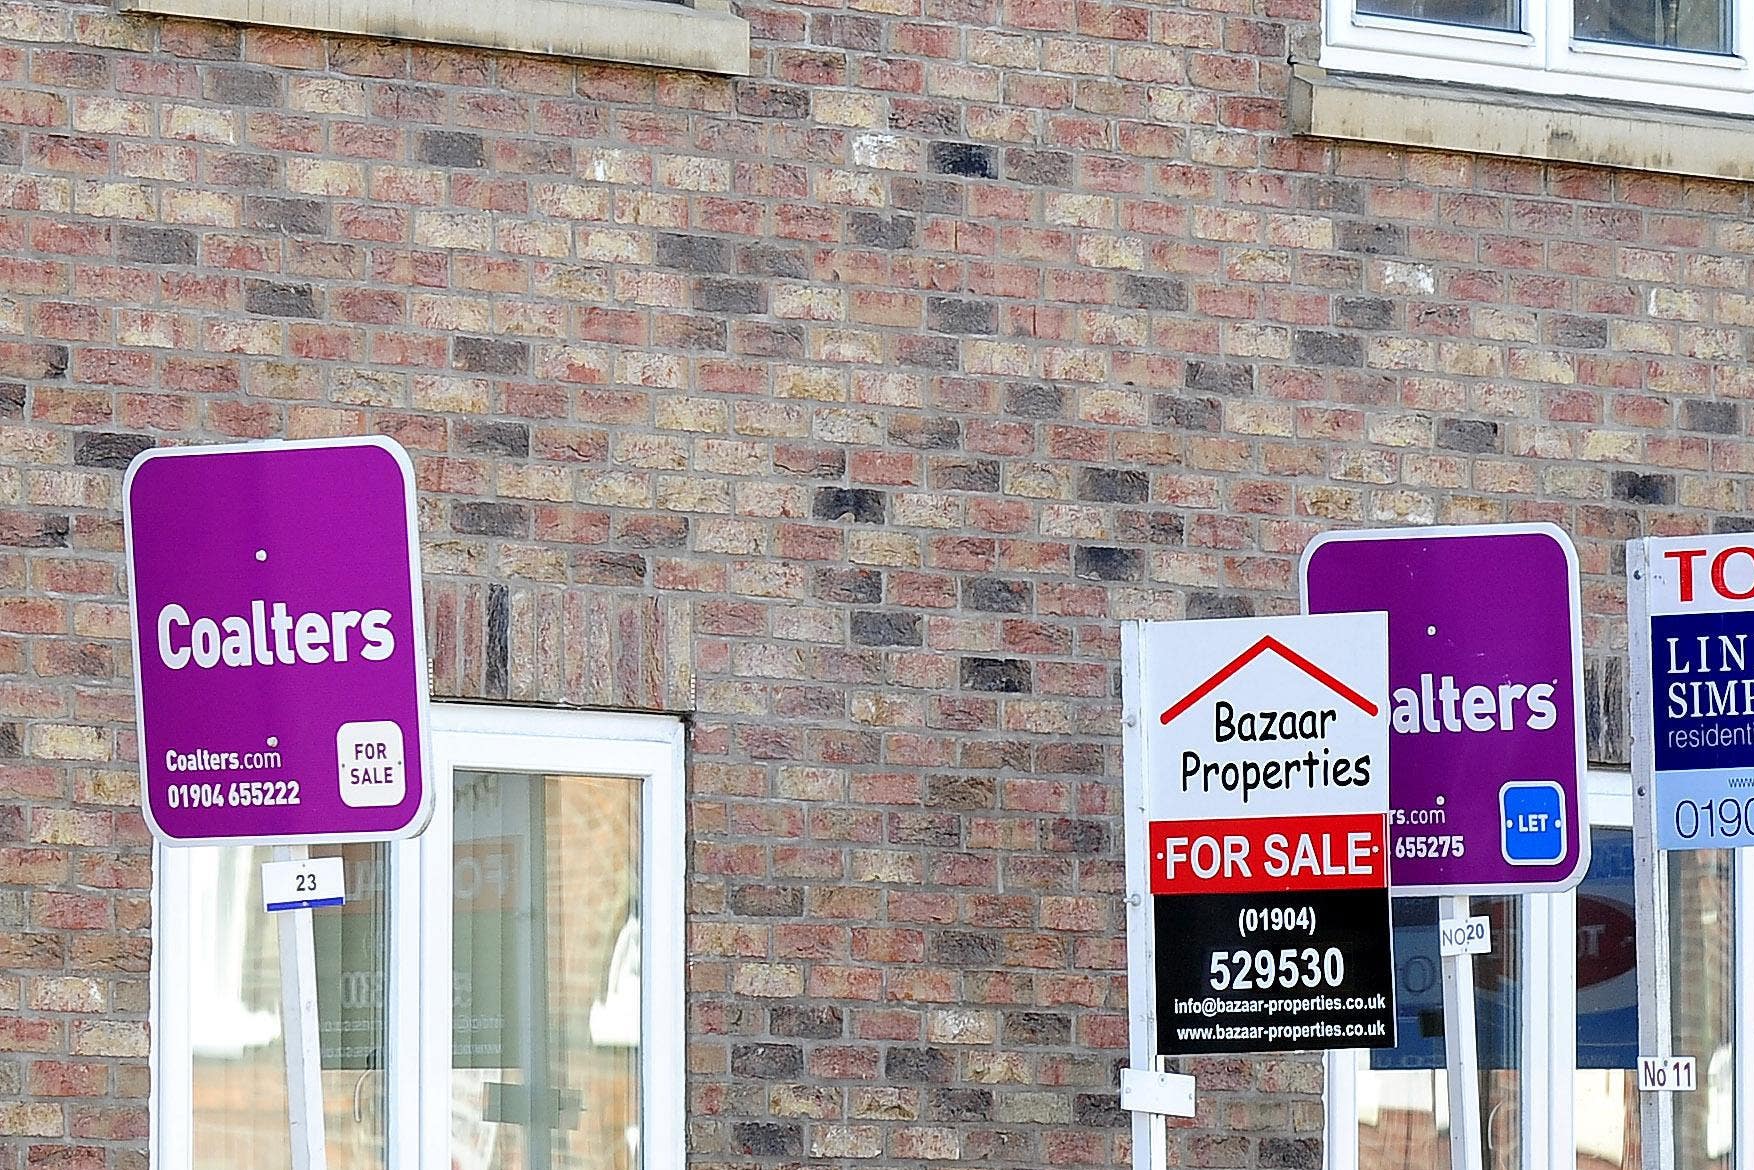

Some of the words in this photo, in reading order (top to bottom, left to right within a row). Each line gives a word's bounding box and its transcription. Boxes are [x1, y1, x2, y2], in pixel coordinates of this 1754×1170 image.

[157, 600, 395, 670] Coalters
[1389, 673, 1557, 734] alters
[1214, 700, 1336, 743] Bazaar
[165, 747, 281, 772] Coalters.com
[355, 742, 387, 761] FOR
[349, 766, 394, 785] SALE
[1182, 748, 1371, 803] Properties
[167, 783, 224, 808] 01904
[229, 780, 300, 806] 655222
[1518, 814, 1548, 832] LET
[1165, 835, 1251, 880] FOR
[1264, 830, 1374, 877] SALE
[1395, 835, 1465, 858] 655275
[295, 873, 317, 892] 23
[1238, 906, 1317, 938] (01904)
[1209, 947, 1345, 991] 529530
[1174, 993, 1386, 1017] info@bazaar-properties.co.uk
[1176, 1020, 1386, 1042] www.bazaar-properties.co.uk
[1643, 1060, 1666, 1087] No
[1672, 1061, 1691, 1087] 11
